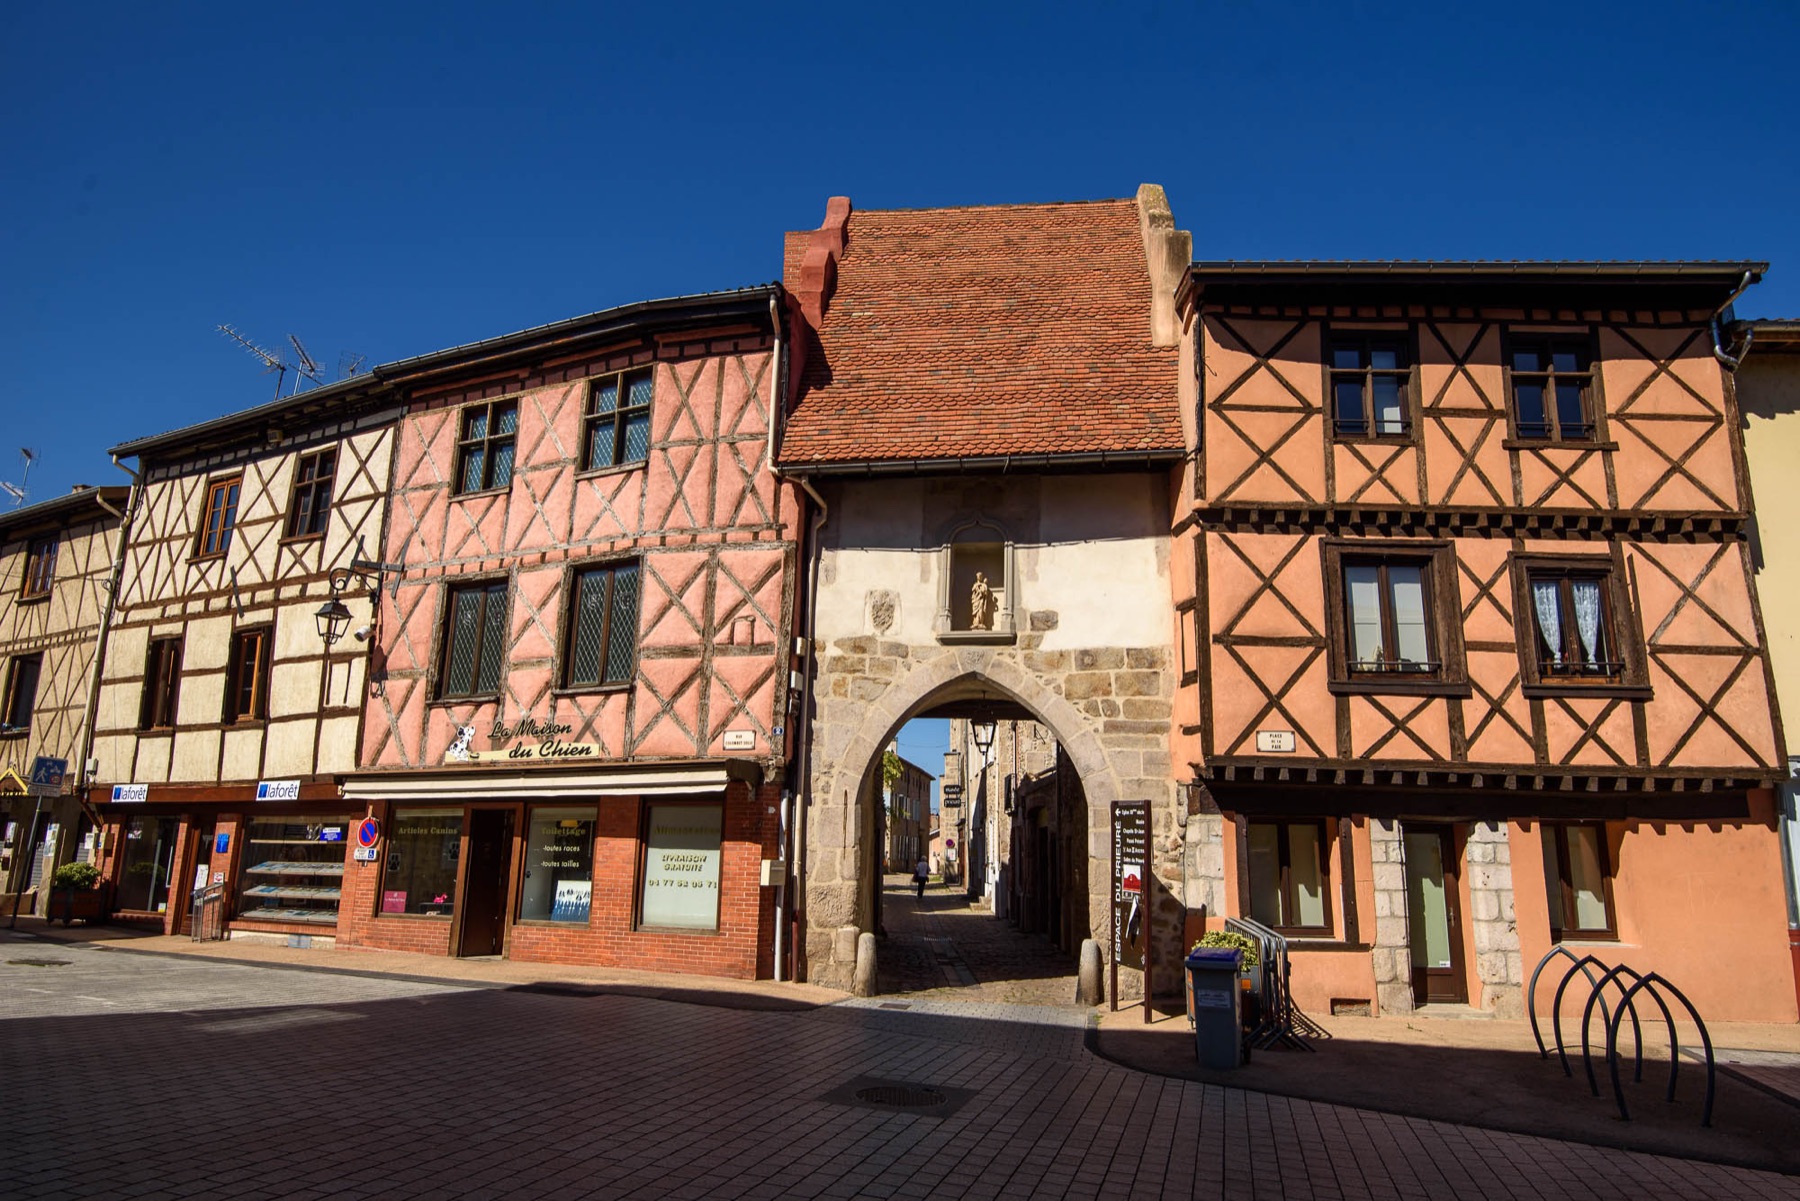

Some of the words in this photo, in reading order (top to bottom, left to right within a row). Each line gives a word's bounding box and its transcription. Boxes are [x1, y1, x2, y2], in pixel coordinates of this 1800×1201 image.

[487, 721, 511, 738] La
[515, 719, 572, 736] Maison
[509, 741, 532, 759] du
[539, 739, 592, 758] Chien
[121, 785, 146, 800] laforêt
[267, 784, 298, 798] laforêt
[1114, 820, 1122, 878] PRIEURÉ
[662, 854, 707, 862] LIVRAISON
[664, 863, 702, 871] GRATUITE
[662, 879, 674, 887] 77
[706, 881, 717, 889] 71
[1115, 883, 1122, 903] DU
[1114, 907, 1122, 963] ESPACE
